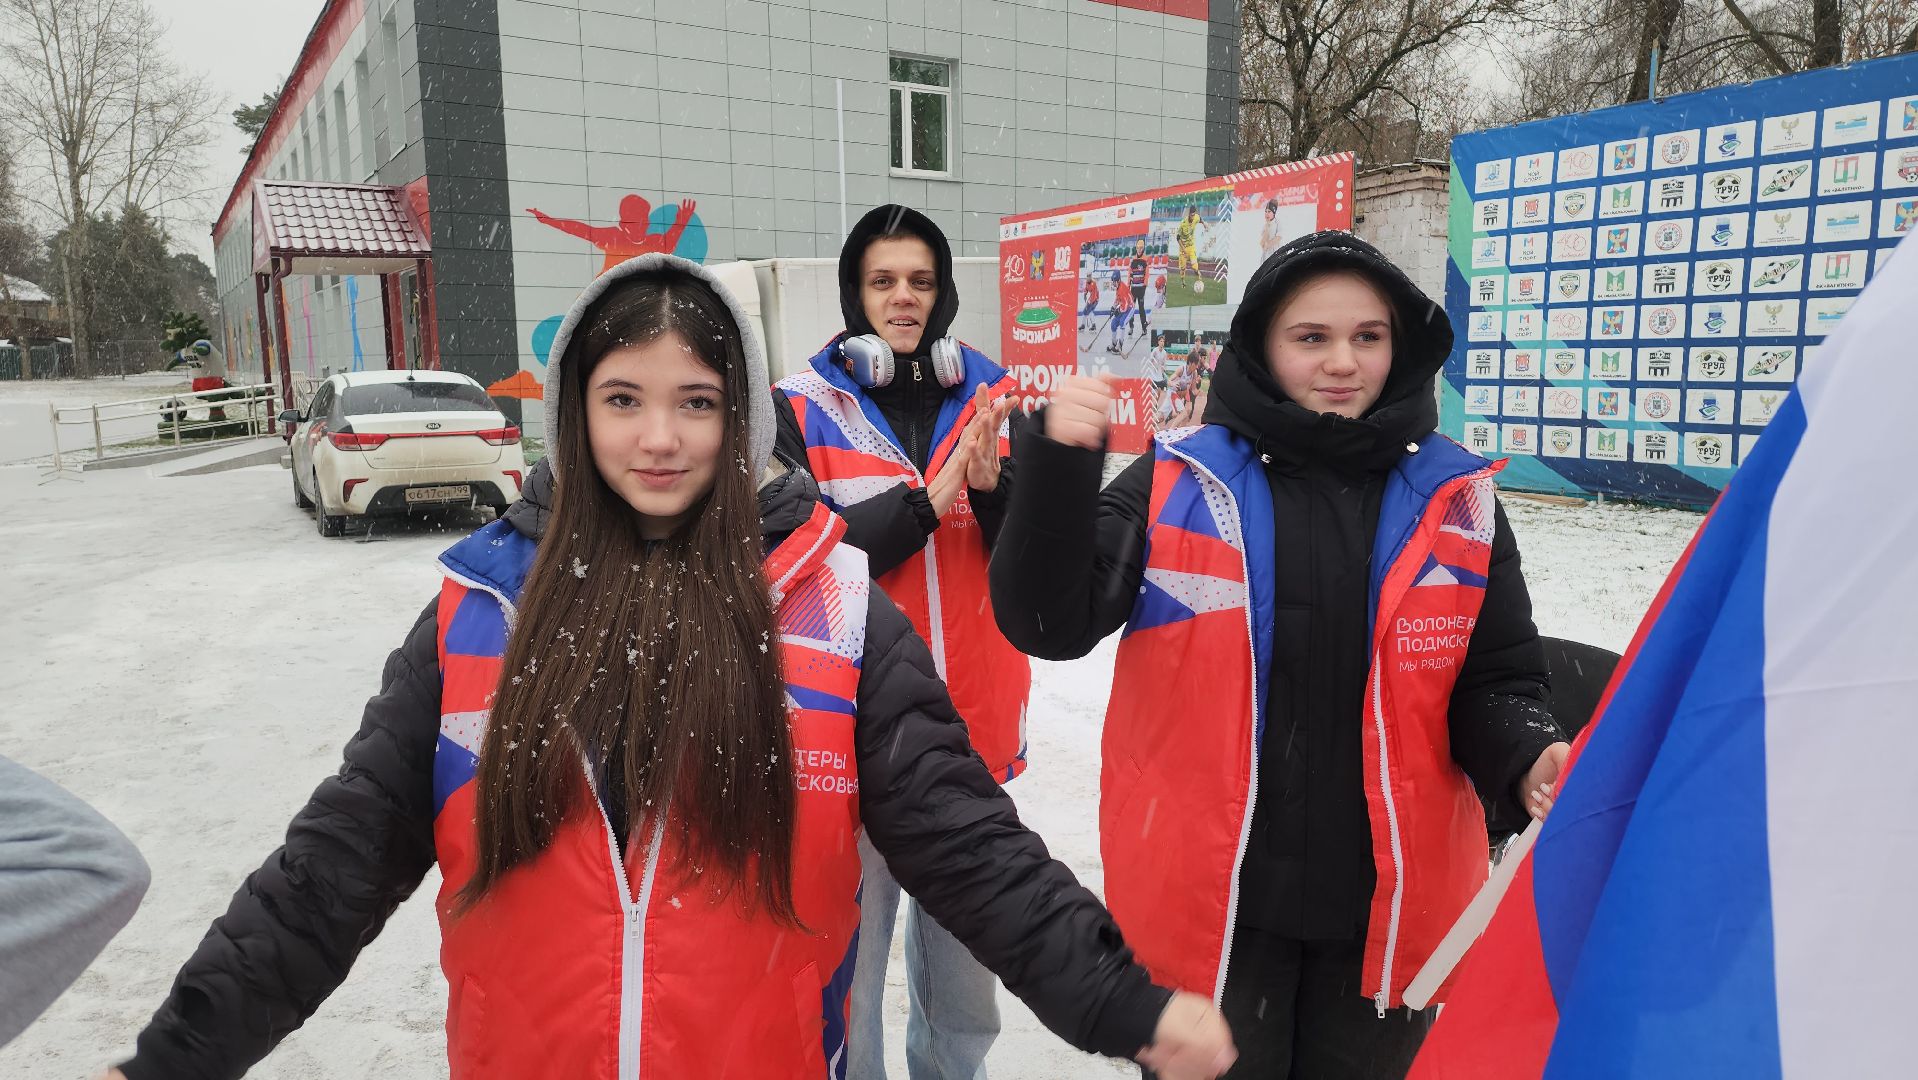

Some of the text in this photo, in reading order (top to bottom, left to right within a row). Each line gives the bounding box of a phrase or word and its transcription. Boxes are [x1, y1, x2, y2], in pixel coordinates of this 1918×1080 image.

[1715, 185, 1740, 194] ТРУД
[1707, 274, 1731, 283] ТРУД
[1012, 322, 1061, 344] УРОЖАЙ
[1701, 361, 1726, 370] ТРУД
[1697, 447, 1721, 457] ТРУД
[1399, 656, 1455, 673] МЫ РЯДОМ
[795, 748, 847, 770] ТЕРЫ
